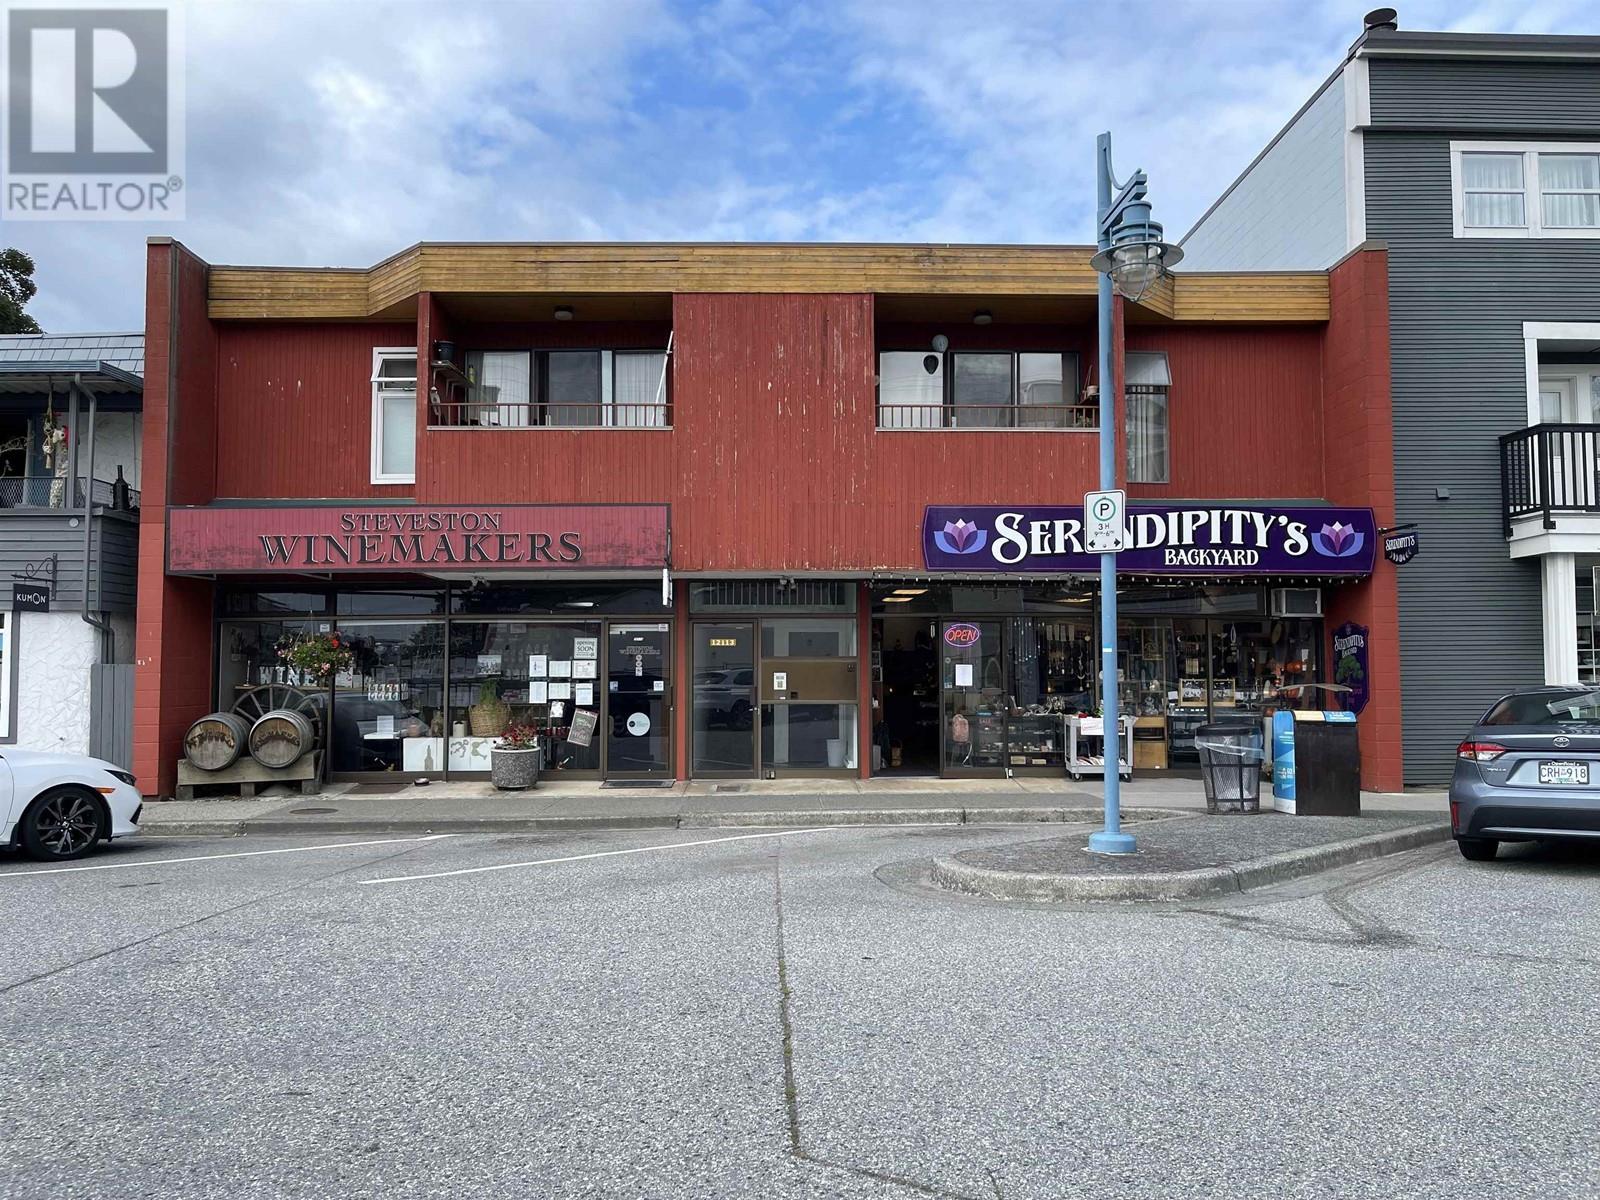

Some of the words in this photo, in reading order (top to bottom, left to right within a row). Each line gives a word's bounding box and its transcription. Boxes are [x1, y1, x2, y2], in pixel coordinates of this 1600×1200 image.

[1100, 503, 1109, 516] P
[341, 512, 501, 531] STEVESTON
[991, 510, 1309, 564] SERDIPITY'S
[258, 532, 582, 564] WINEMAKERS
[1164, 548, 1259, 566] BACKYARD
[16, 592, 47, 605] KUMON
[947, 629, 976, 641] OPEN
[1541, 768, 1560, 778] CRH
[1566, 768, 1587, 778] 918
